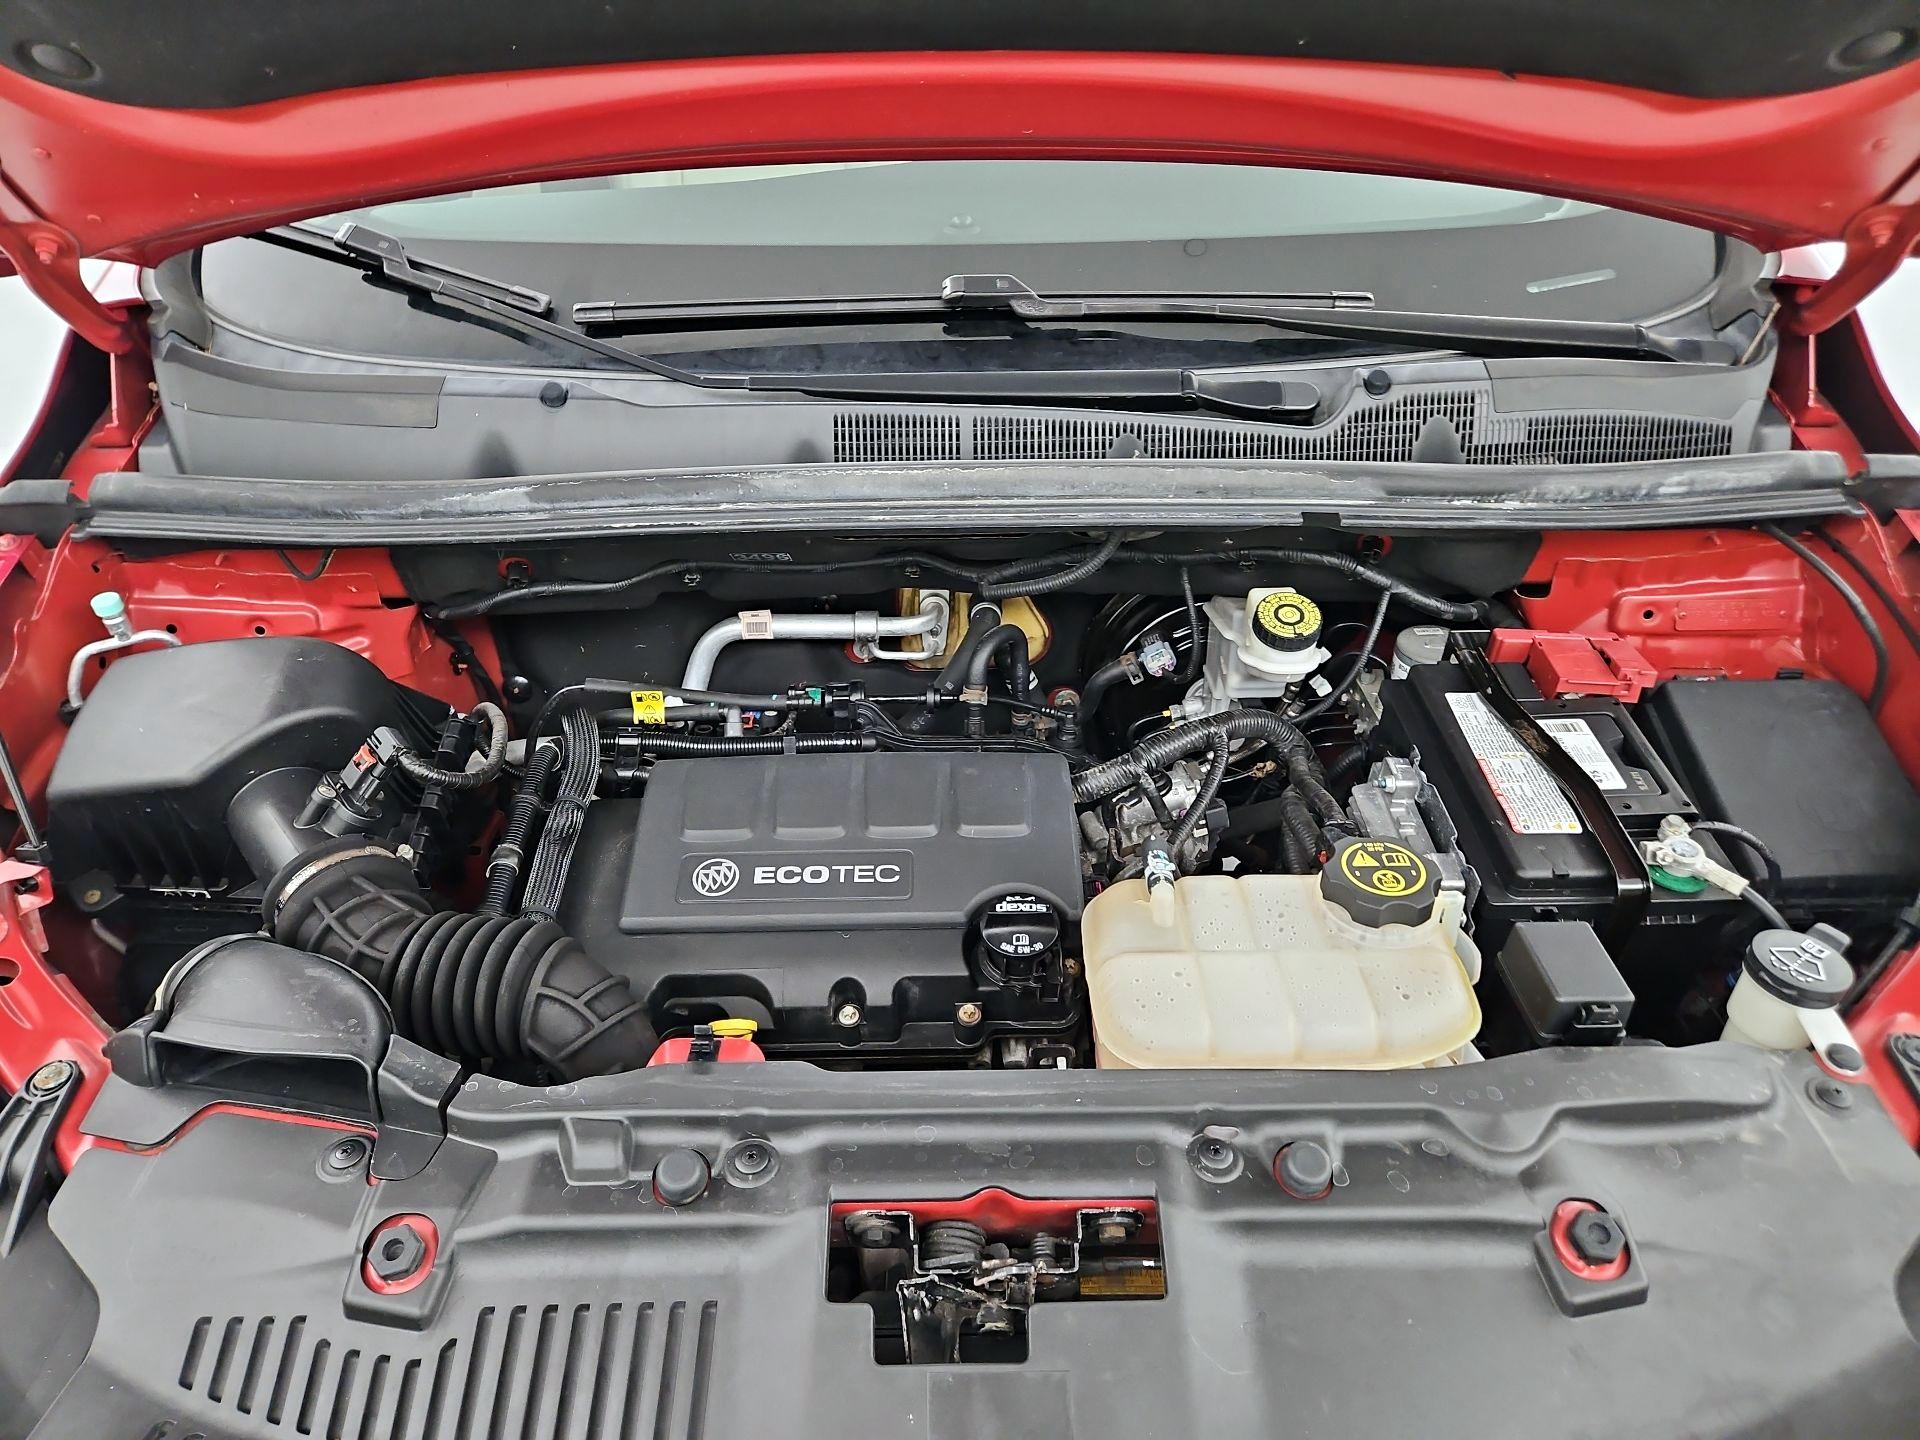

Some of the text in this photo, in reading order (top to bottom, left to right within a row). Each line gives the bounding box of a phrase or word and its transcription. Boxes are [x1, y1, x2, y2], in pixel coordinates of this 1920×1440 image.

[753, 864, 901, 885] ECOTEC
[995, 901, 1047, 912] dexos
[1000, 942, 1044, 954] SAE 5W-30
